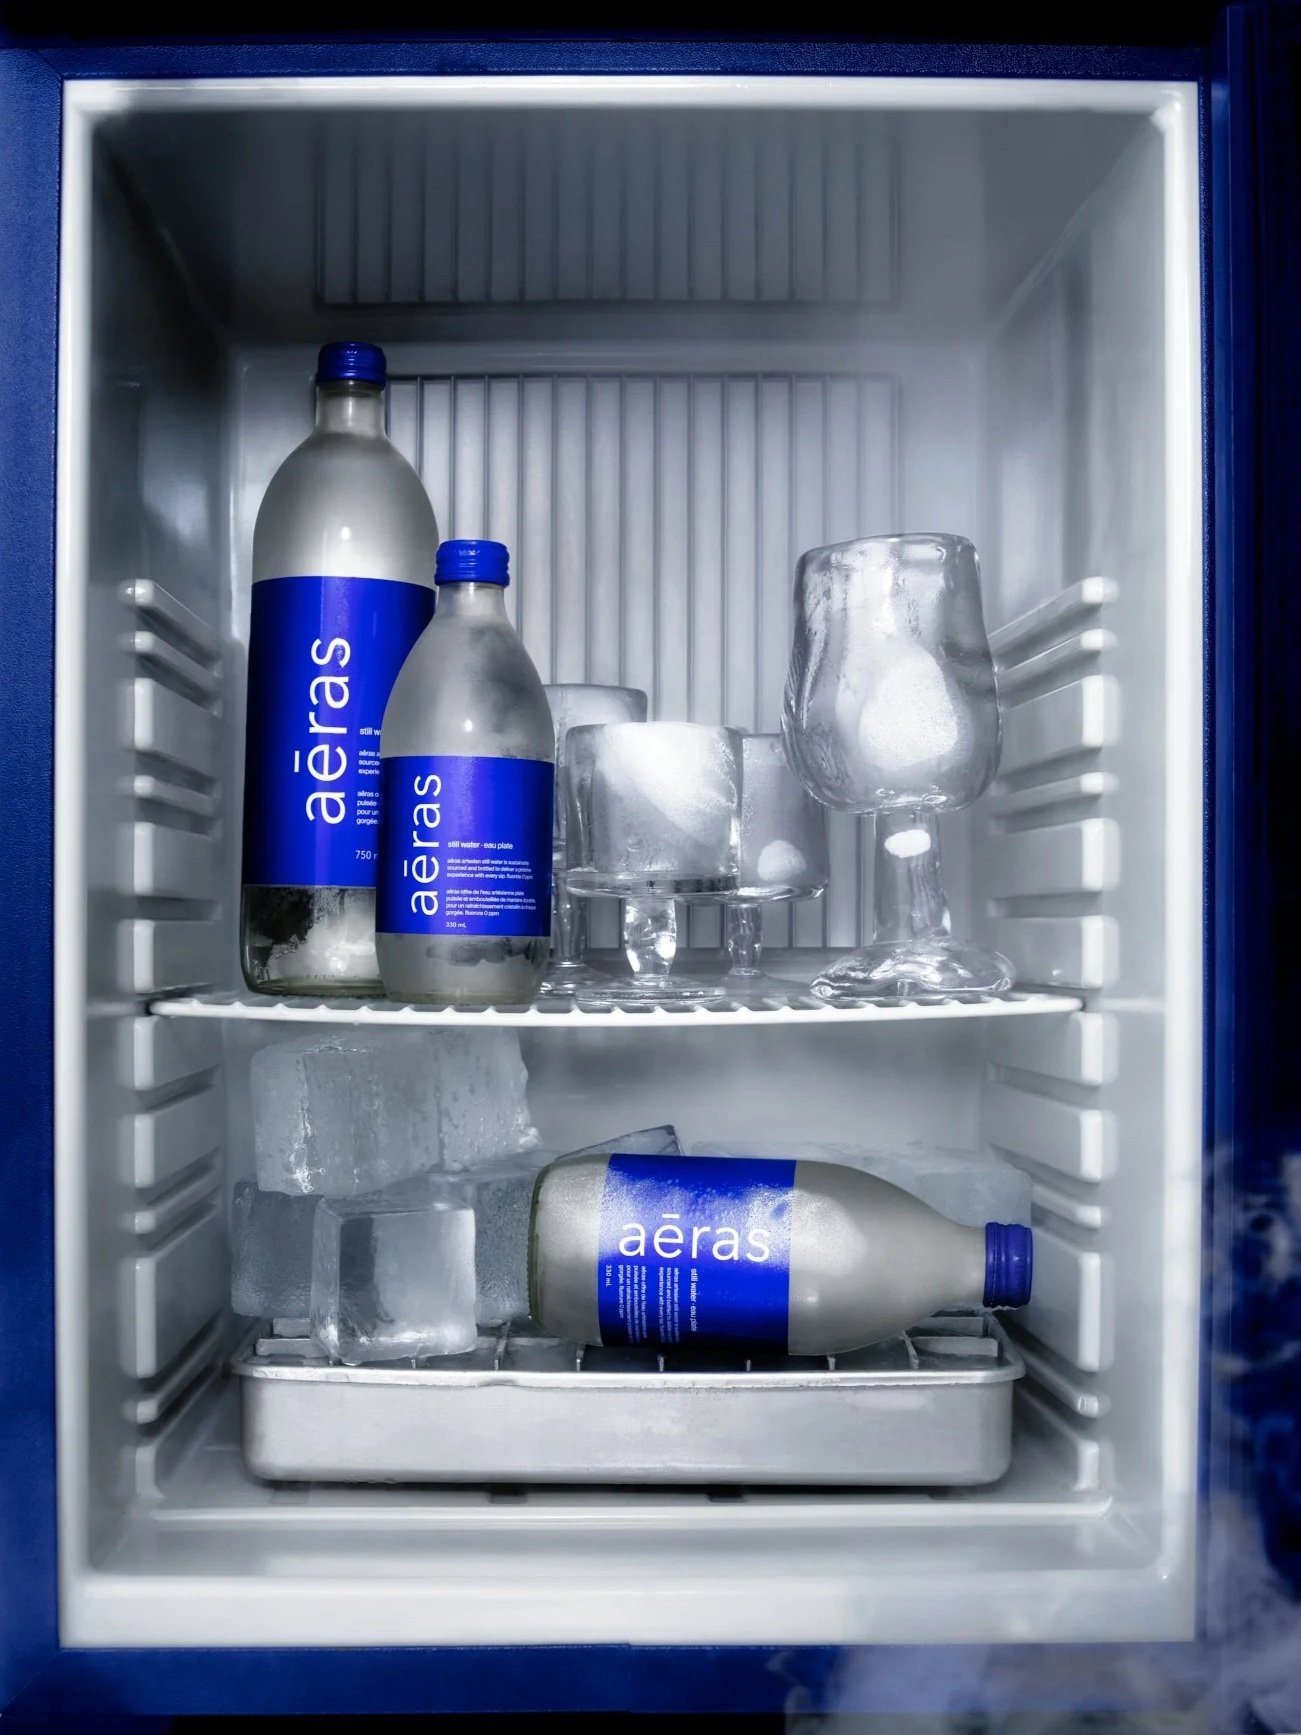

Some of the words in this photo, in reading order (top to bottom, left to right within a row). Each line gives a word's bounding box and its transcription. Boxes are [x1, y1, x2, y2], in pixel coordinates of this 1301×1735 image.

[294, 637, 351, 825] aēras
[359, 727, 373, 735] still
[403, 774, 442, 916] aēras
[355, 849, 372, 860] 750
[618, 1213, 771, 1262] aēras
[605, 1277, 612, 1287] mL
[690, 1268, 698, 1282] still
[690, 1282, 698, 1302] water
[690, 1305, 698, 1318] eau
